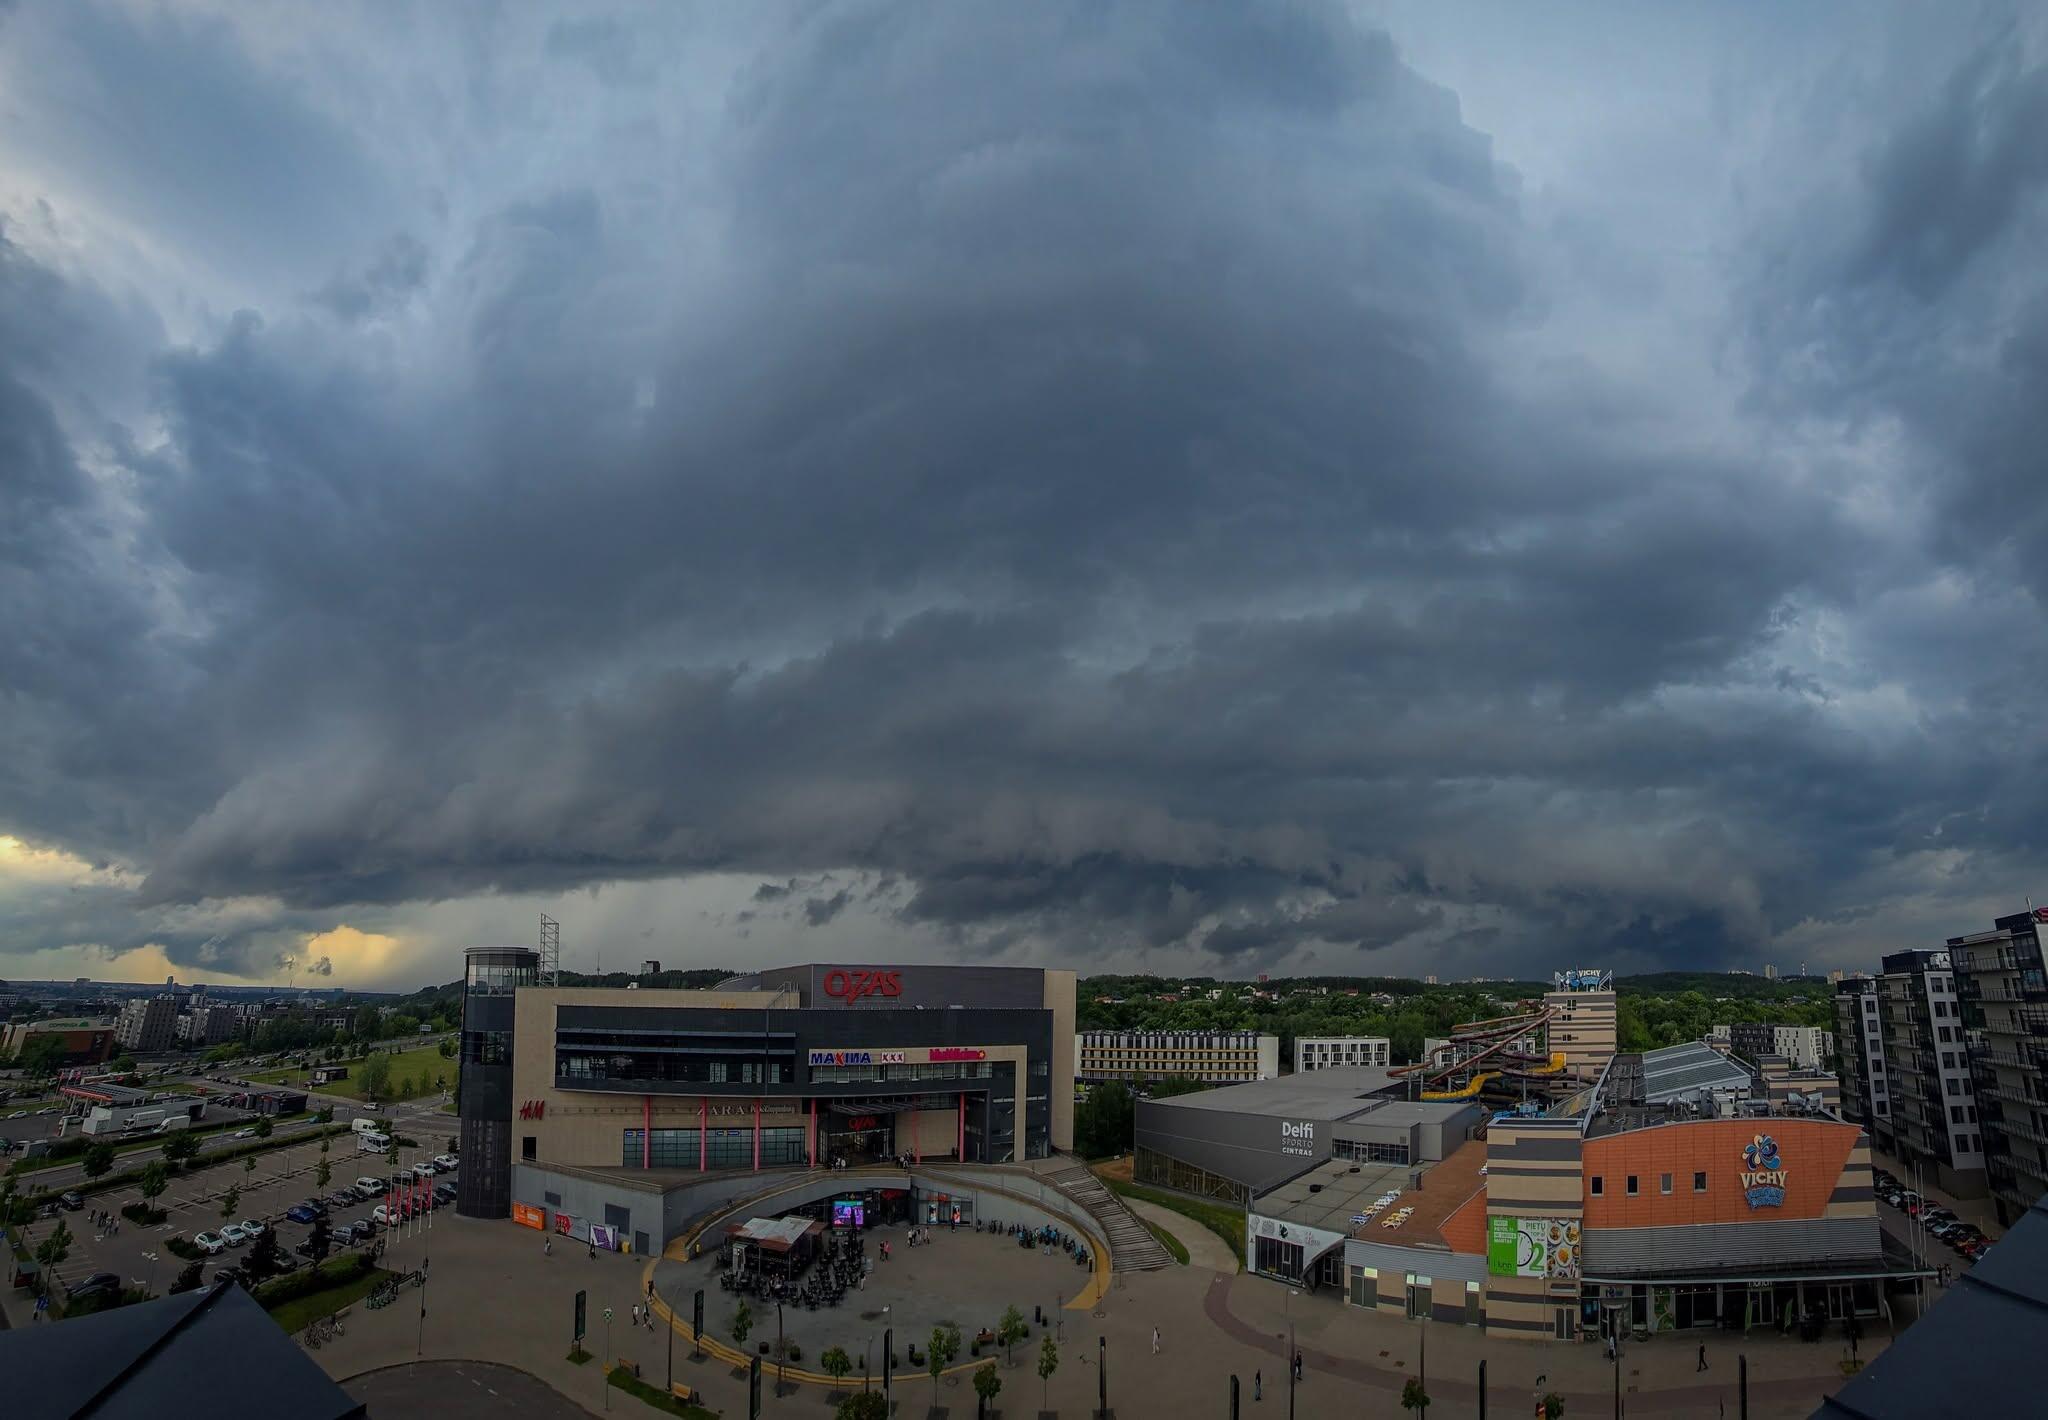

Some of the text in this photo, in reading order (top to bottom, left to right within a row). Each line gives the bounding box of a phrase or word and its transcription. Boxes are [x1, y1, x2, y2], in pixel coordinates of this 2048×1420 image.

[1578, 969, 1601, 978] VICHY
[824, 970, 903, 1006] OZAS
[810, 1052, 871, 1066] MAXIMA
[1282, 1121, 1314, 1139] Delfi
[1281, 1138, 1314, 1149] SPORTO
[1282, 1147, 1313, 1157] CENTRAS
[1740, 1170, 1788, 1190] VICHY
[1529, 1242, 1545, 1271] 2
